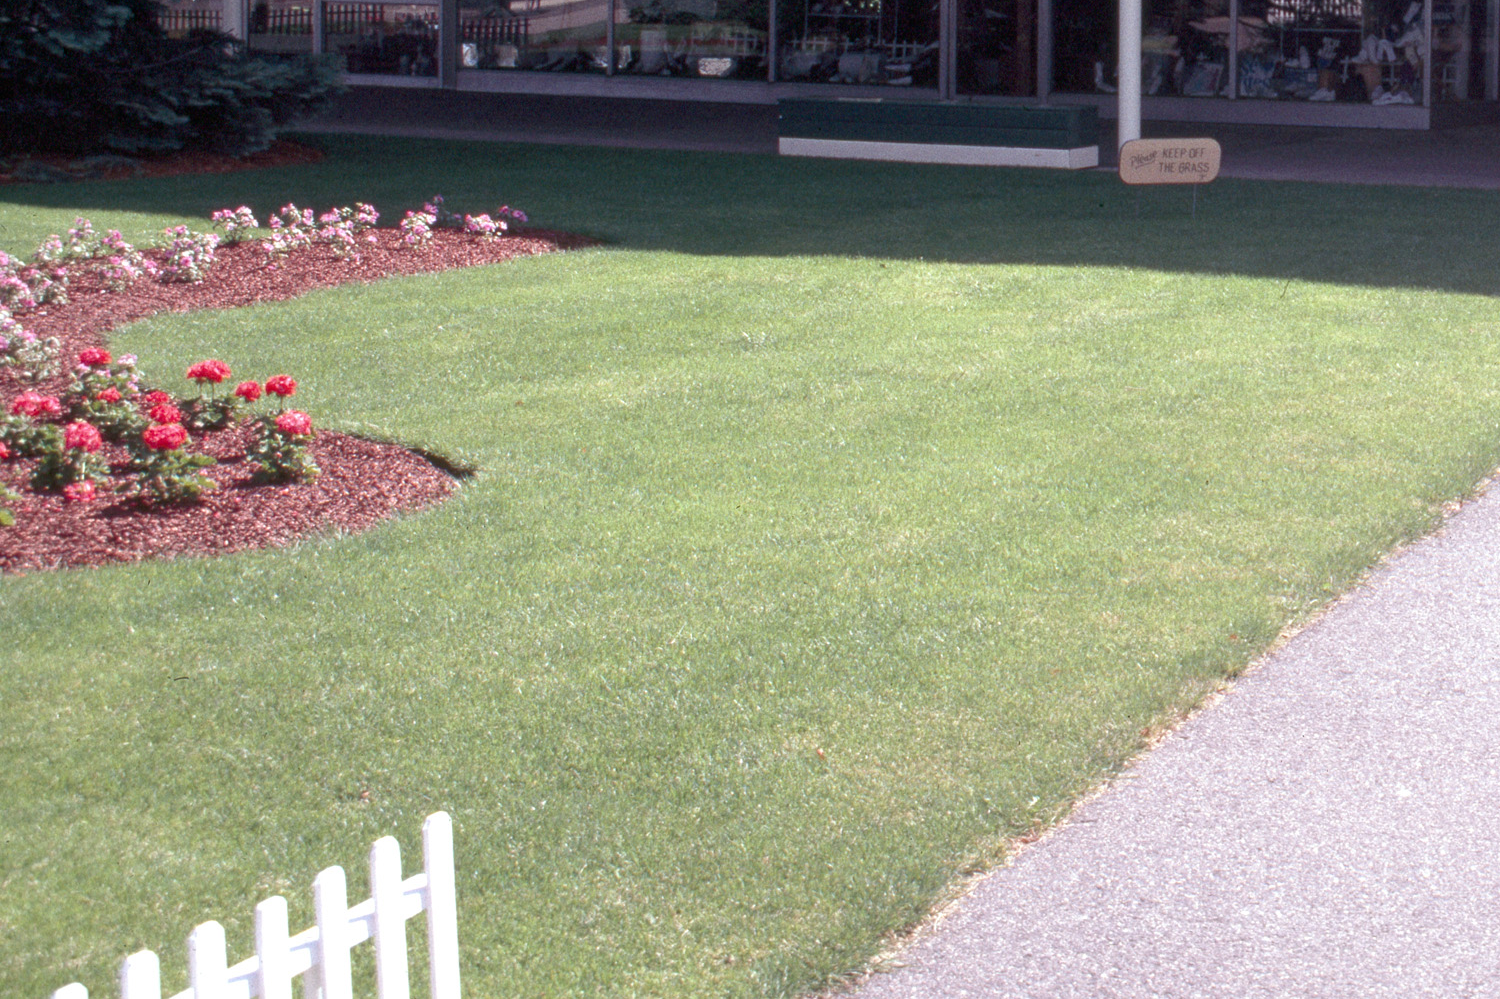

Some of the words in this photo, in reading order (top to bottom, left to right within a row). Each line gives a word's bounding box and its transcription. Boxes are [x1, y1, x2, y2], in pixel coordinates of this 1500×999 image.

[1163, 148, 1188, 158] KEEP
[1189, 148, 1206, 158] OFF
[1159, 162, 1175, 173] THE
[1179, 162, 1209, 174] GRASS
